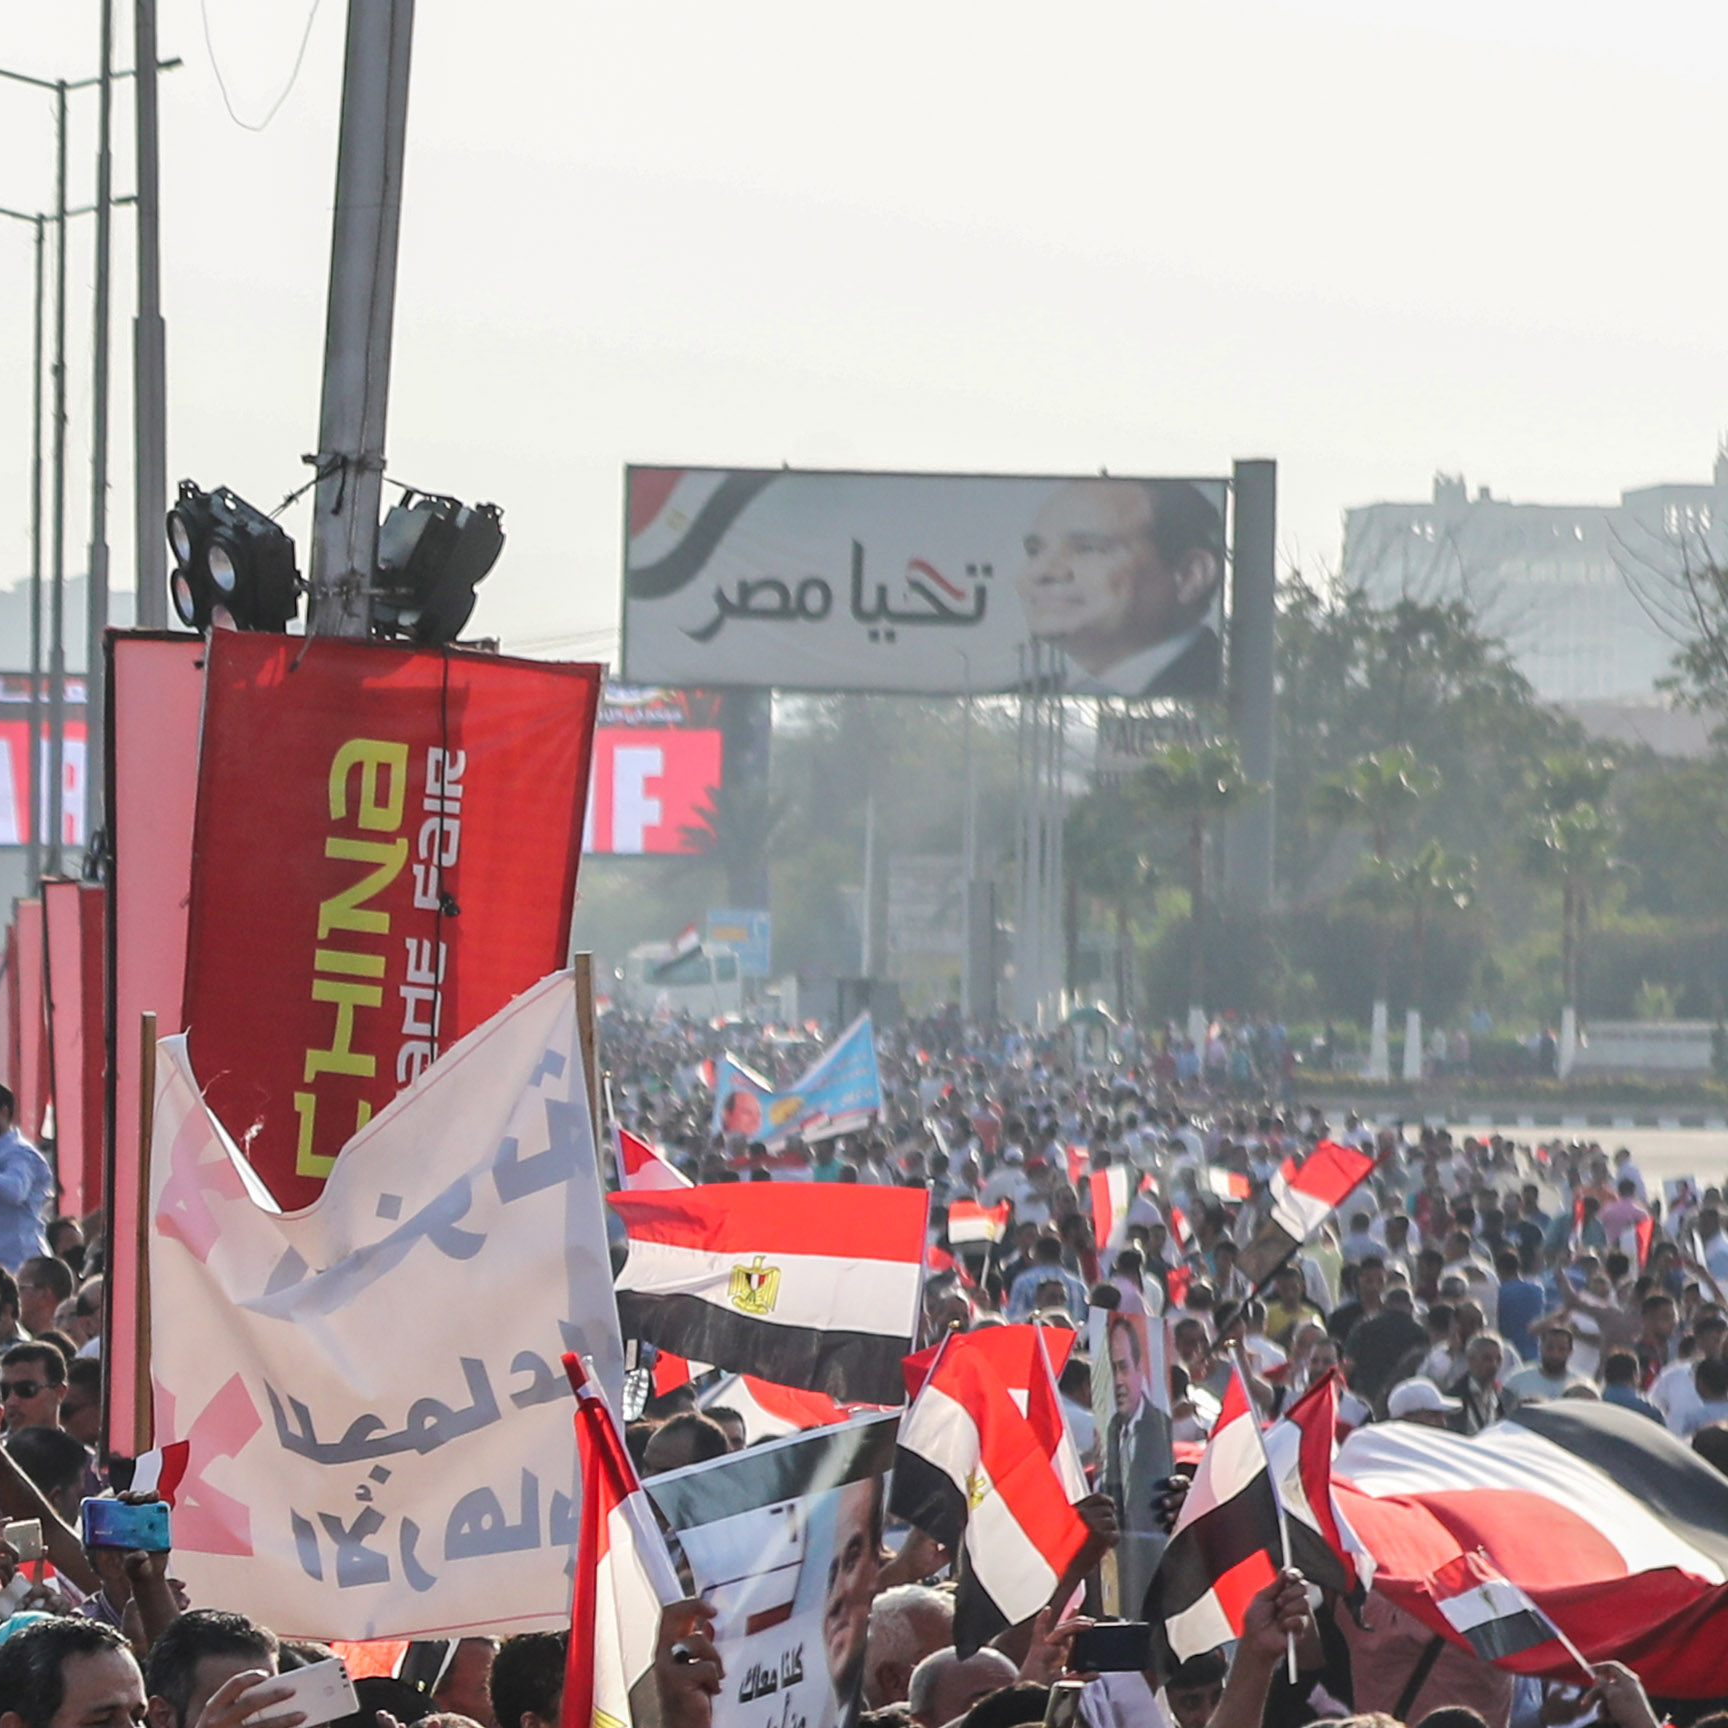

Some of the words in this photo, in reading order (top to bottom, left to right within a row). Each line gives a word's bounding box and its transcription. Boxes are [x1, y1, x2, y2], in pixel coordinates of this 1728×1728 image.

[678, 577, 832, 642] مصر
[851, 538, 993, 643] تحيا
[780, 1641, 804, 1689] كلنا
